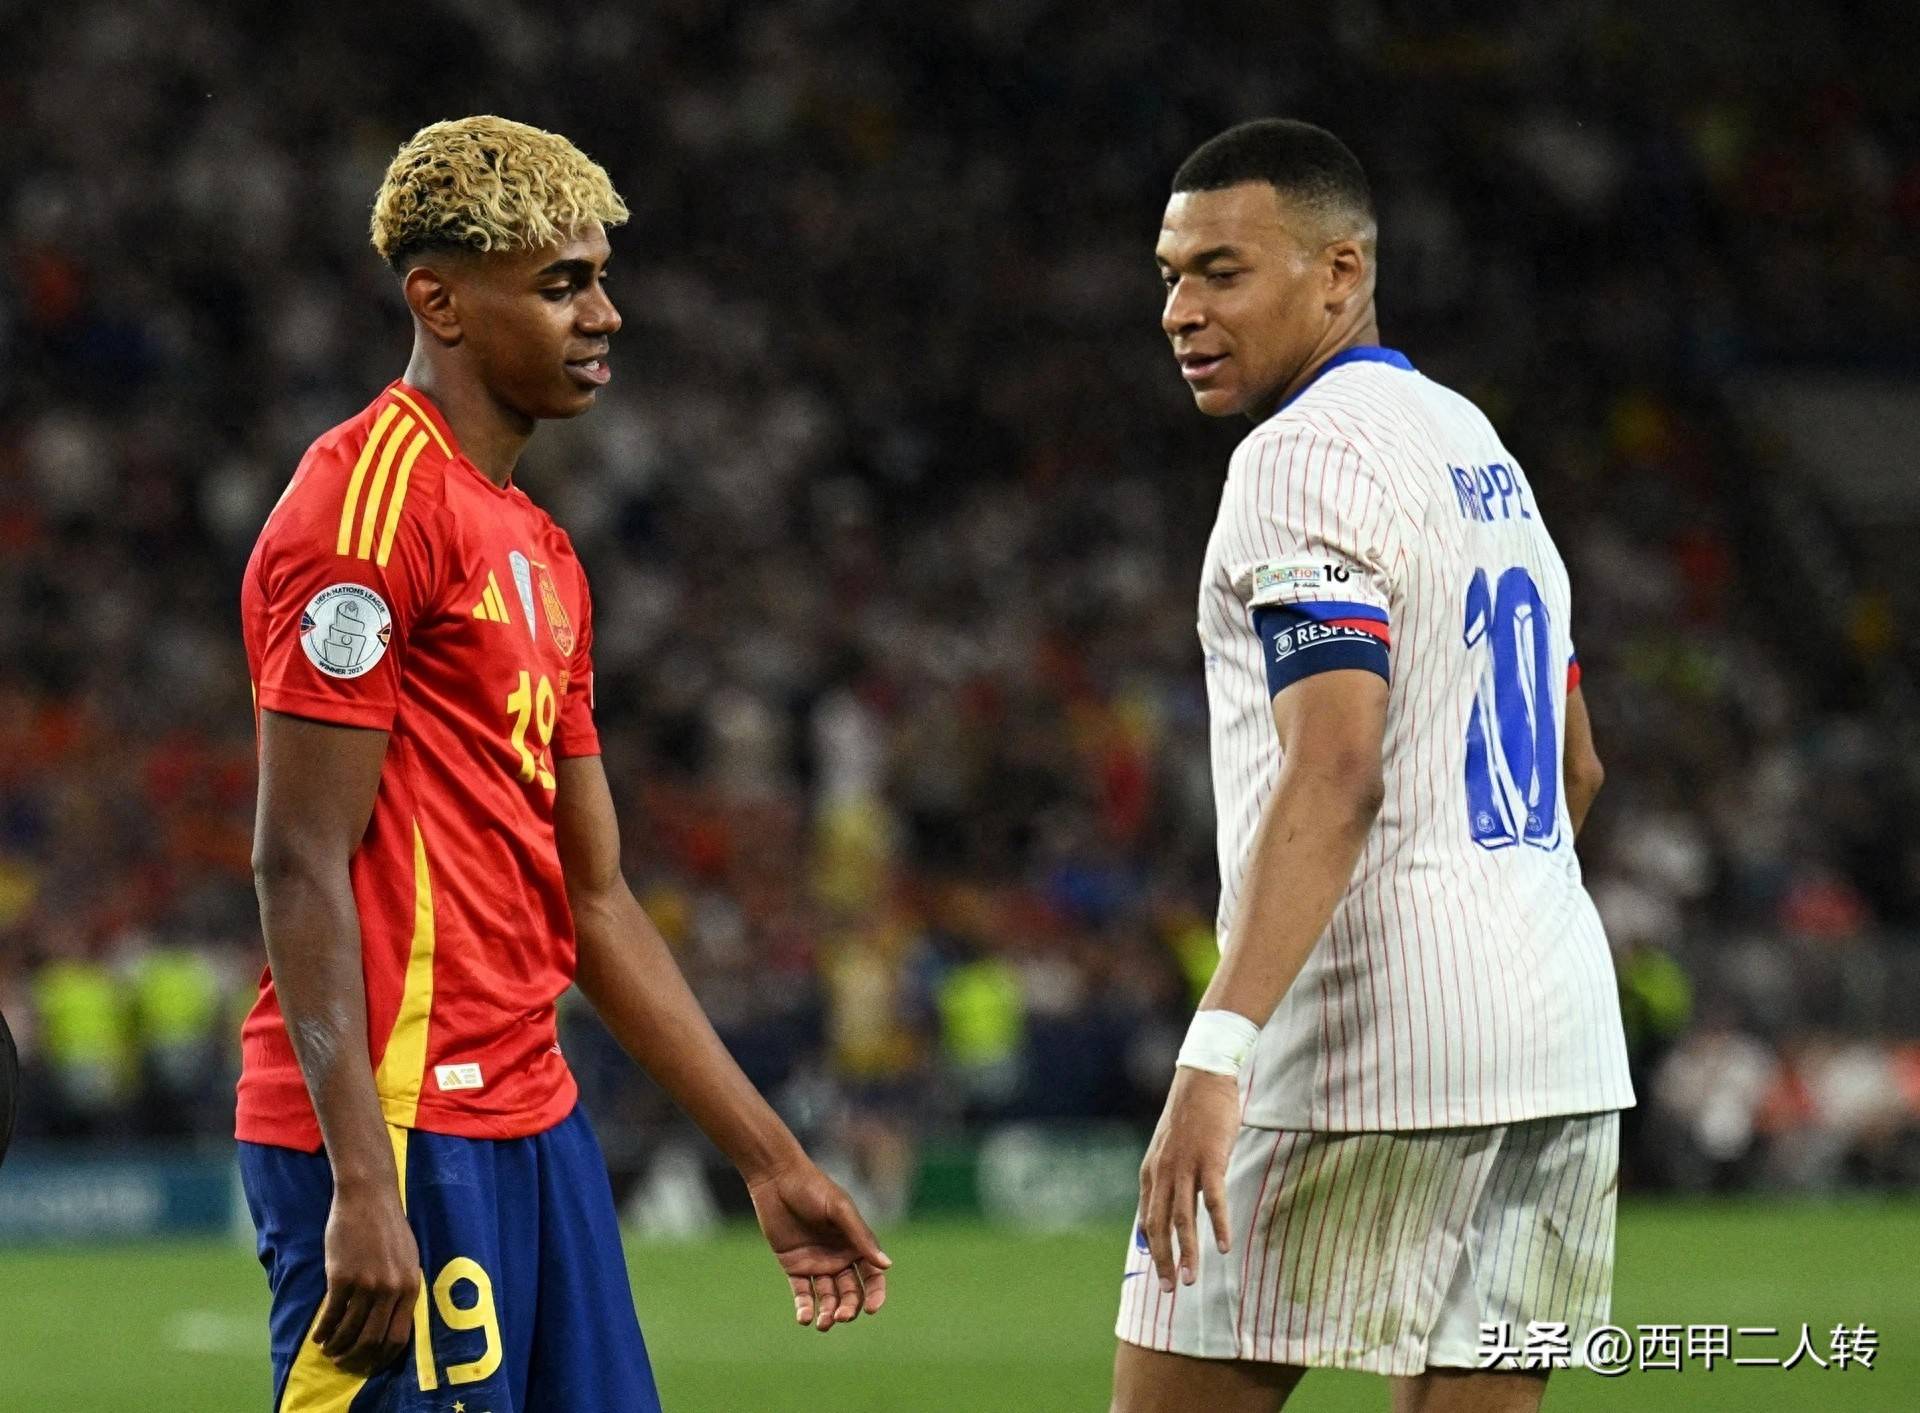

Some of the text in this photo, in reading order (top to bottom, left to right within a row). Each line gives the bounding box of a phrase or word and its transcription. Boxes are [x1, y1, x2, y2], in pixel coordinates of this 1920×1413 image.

[332, 587, 364, 596] NATIONS
[364, 592, 386, 613] LEAGUE
[319, 660, 346, 675] WINNER
[1463, 566, 1562, 852] 10
[507, 670, 556, 790] 19
[413, 1256, 503, 1392] 19
